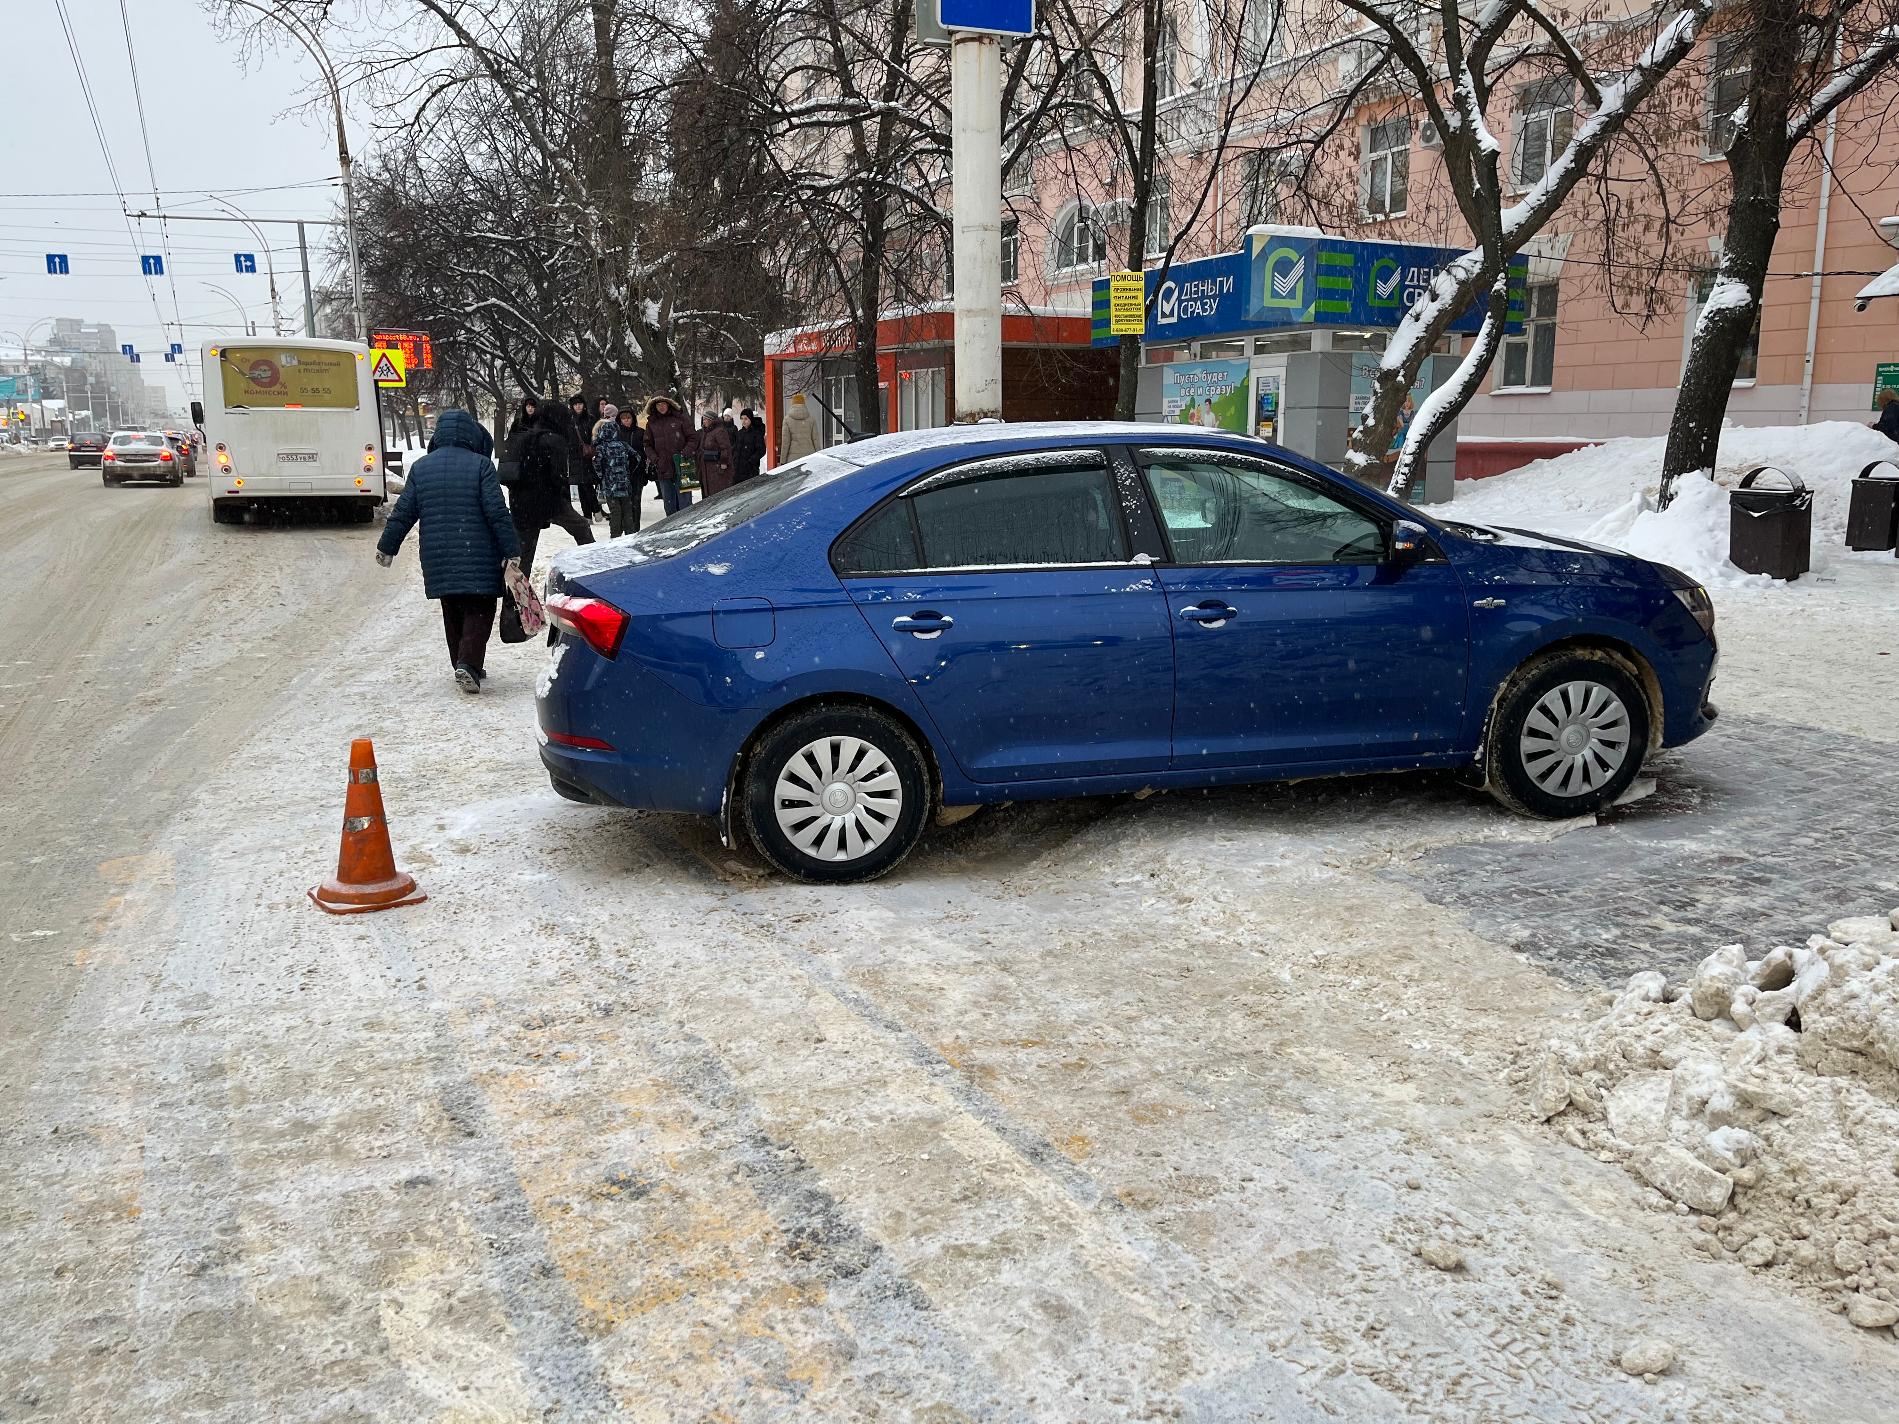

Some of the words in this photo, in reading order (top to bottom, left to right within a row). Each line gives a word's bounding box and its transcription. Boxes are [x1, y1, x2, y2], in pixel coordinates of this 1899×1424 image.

[1110, 274, 1143, 282] ПОМОЩЬ
[1181, 275, 1234, 300] ДЕНЬГИ
[1180, 297, 1220, 319] СРАЗУ
[1173, 371, 1199, 386] Пусть
[1202, 368, 1228, 382] будет
[1180, 385, 1195, 397] всё
[1197, 386, 1203, 396] и
[1205, 381, 1235, 398] сразу!
